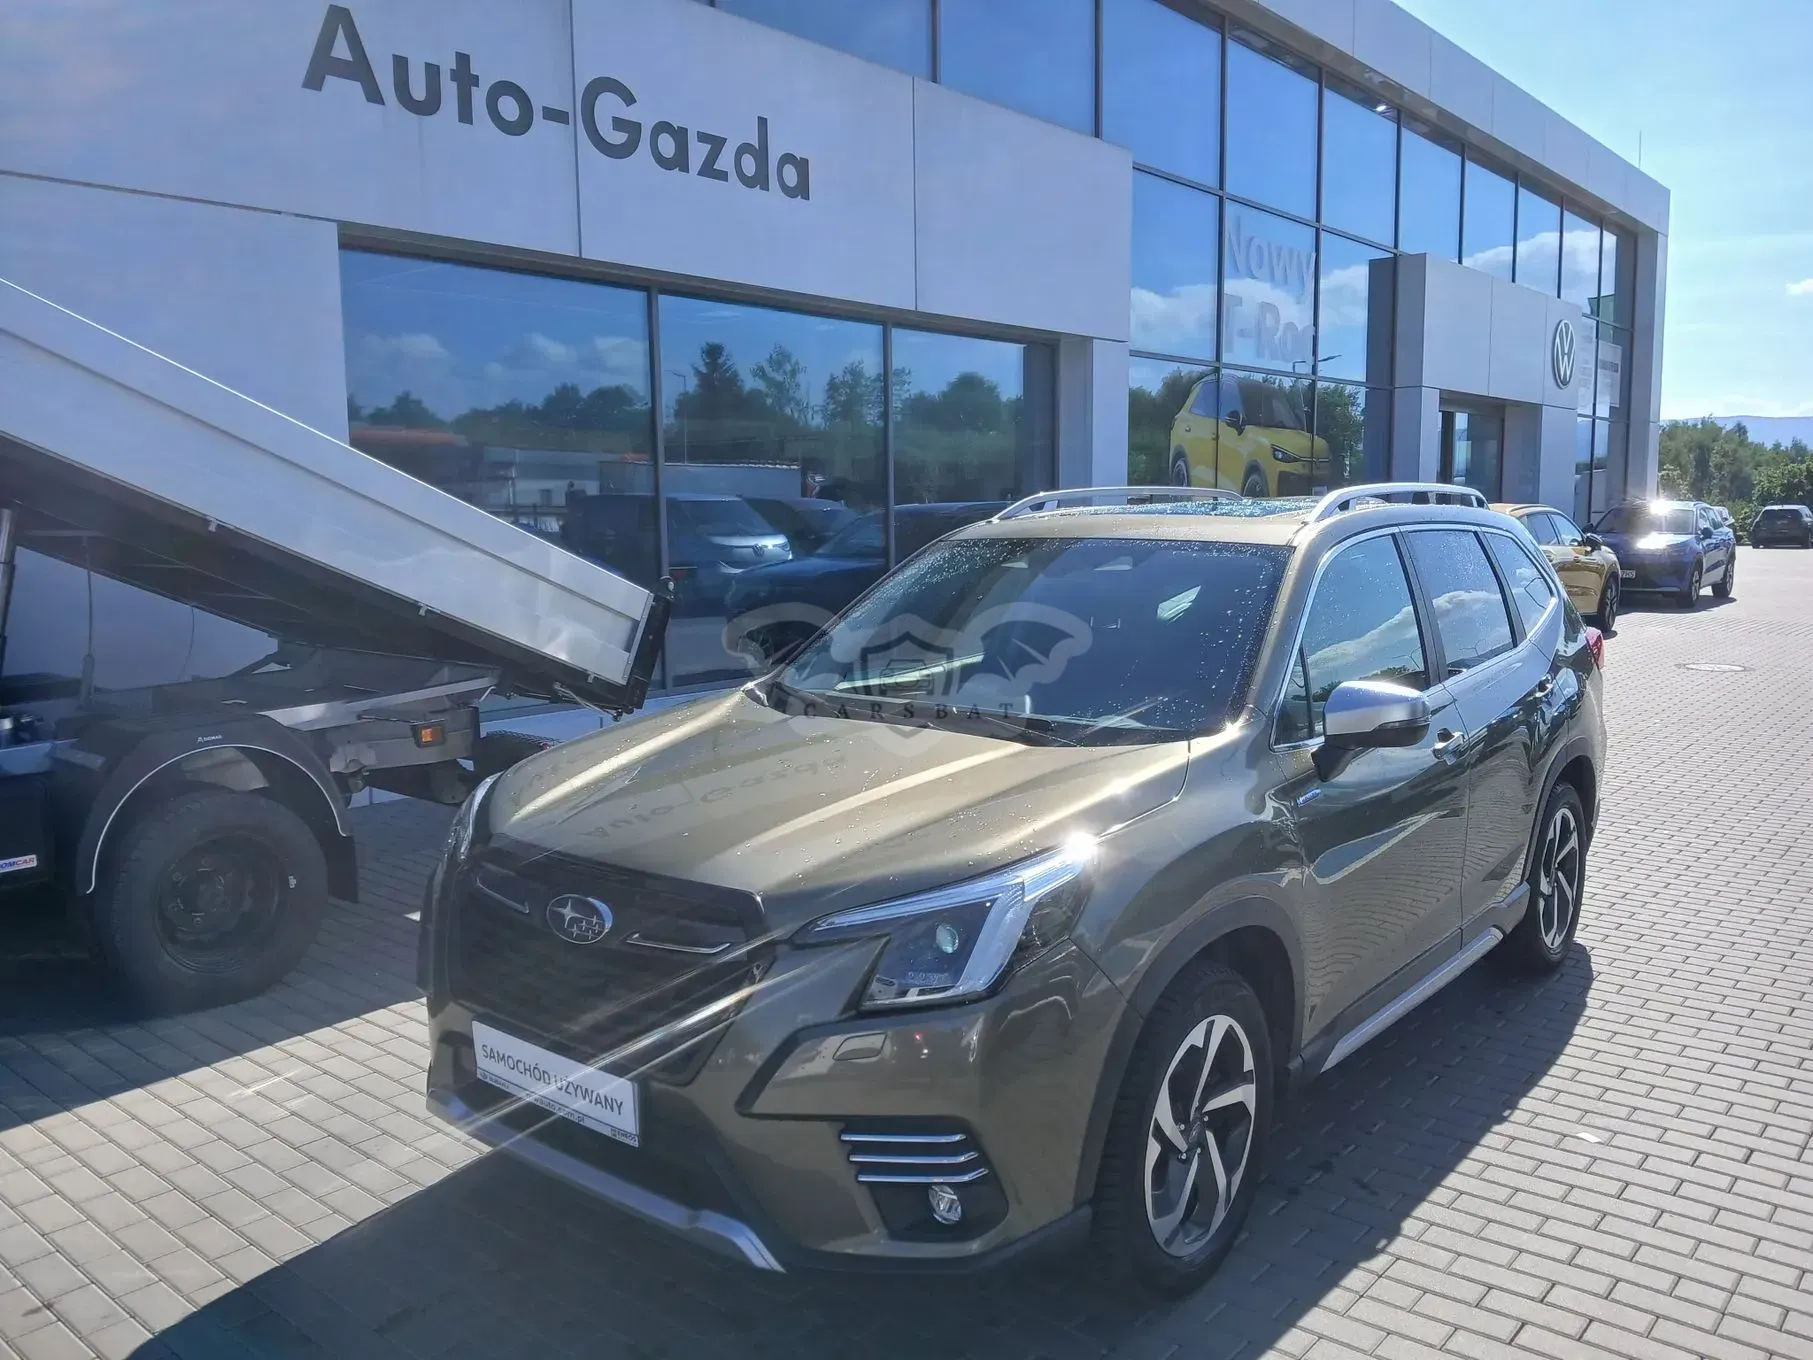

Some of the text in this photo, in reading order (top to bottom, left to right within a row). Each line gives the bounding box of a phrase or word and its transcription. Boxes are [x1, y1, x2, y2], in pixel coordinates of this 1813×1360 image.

[301, 4, 810, 200] Auto-Gazda
[481, 1044, 552, 1085] SAMOCHÓD
[553, 1073, 623, 1116] UŻYWANY
